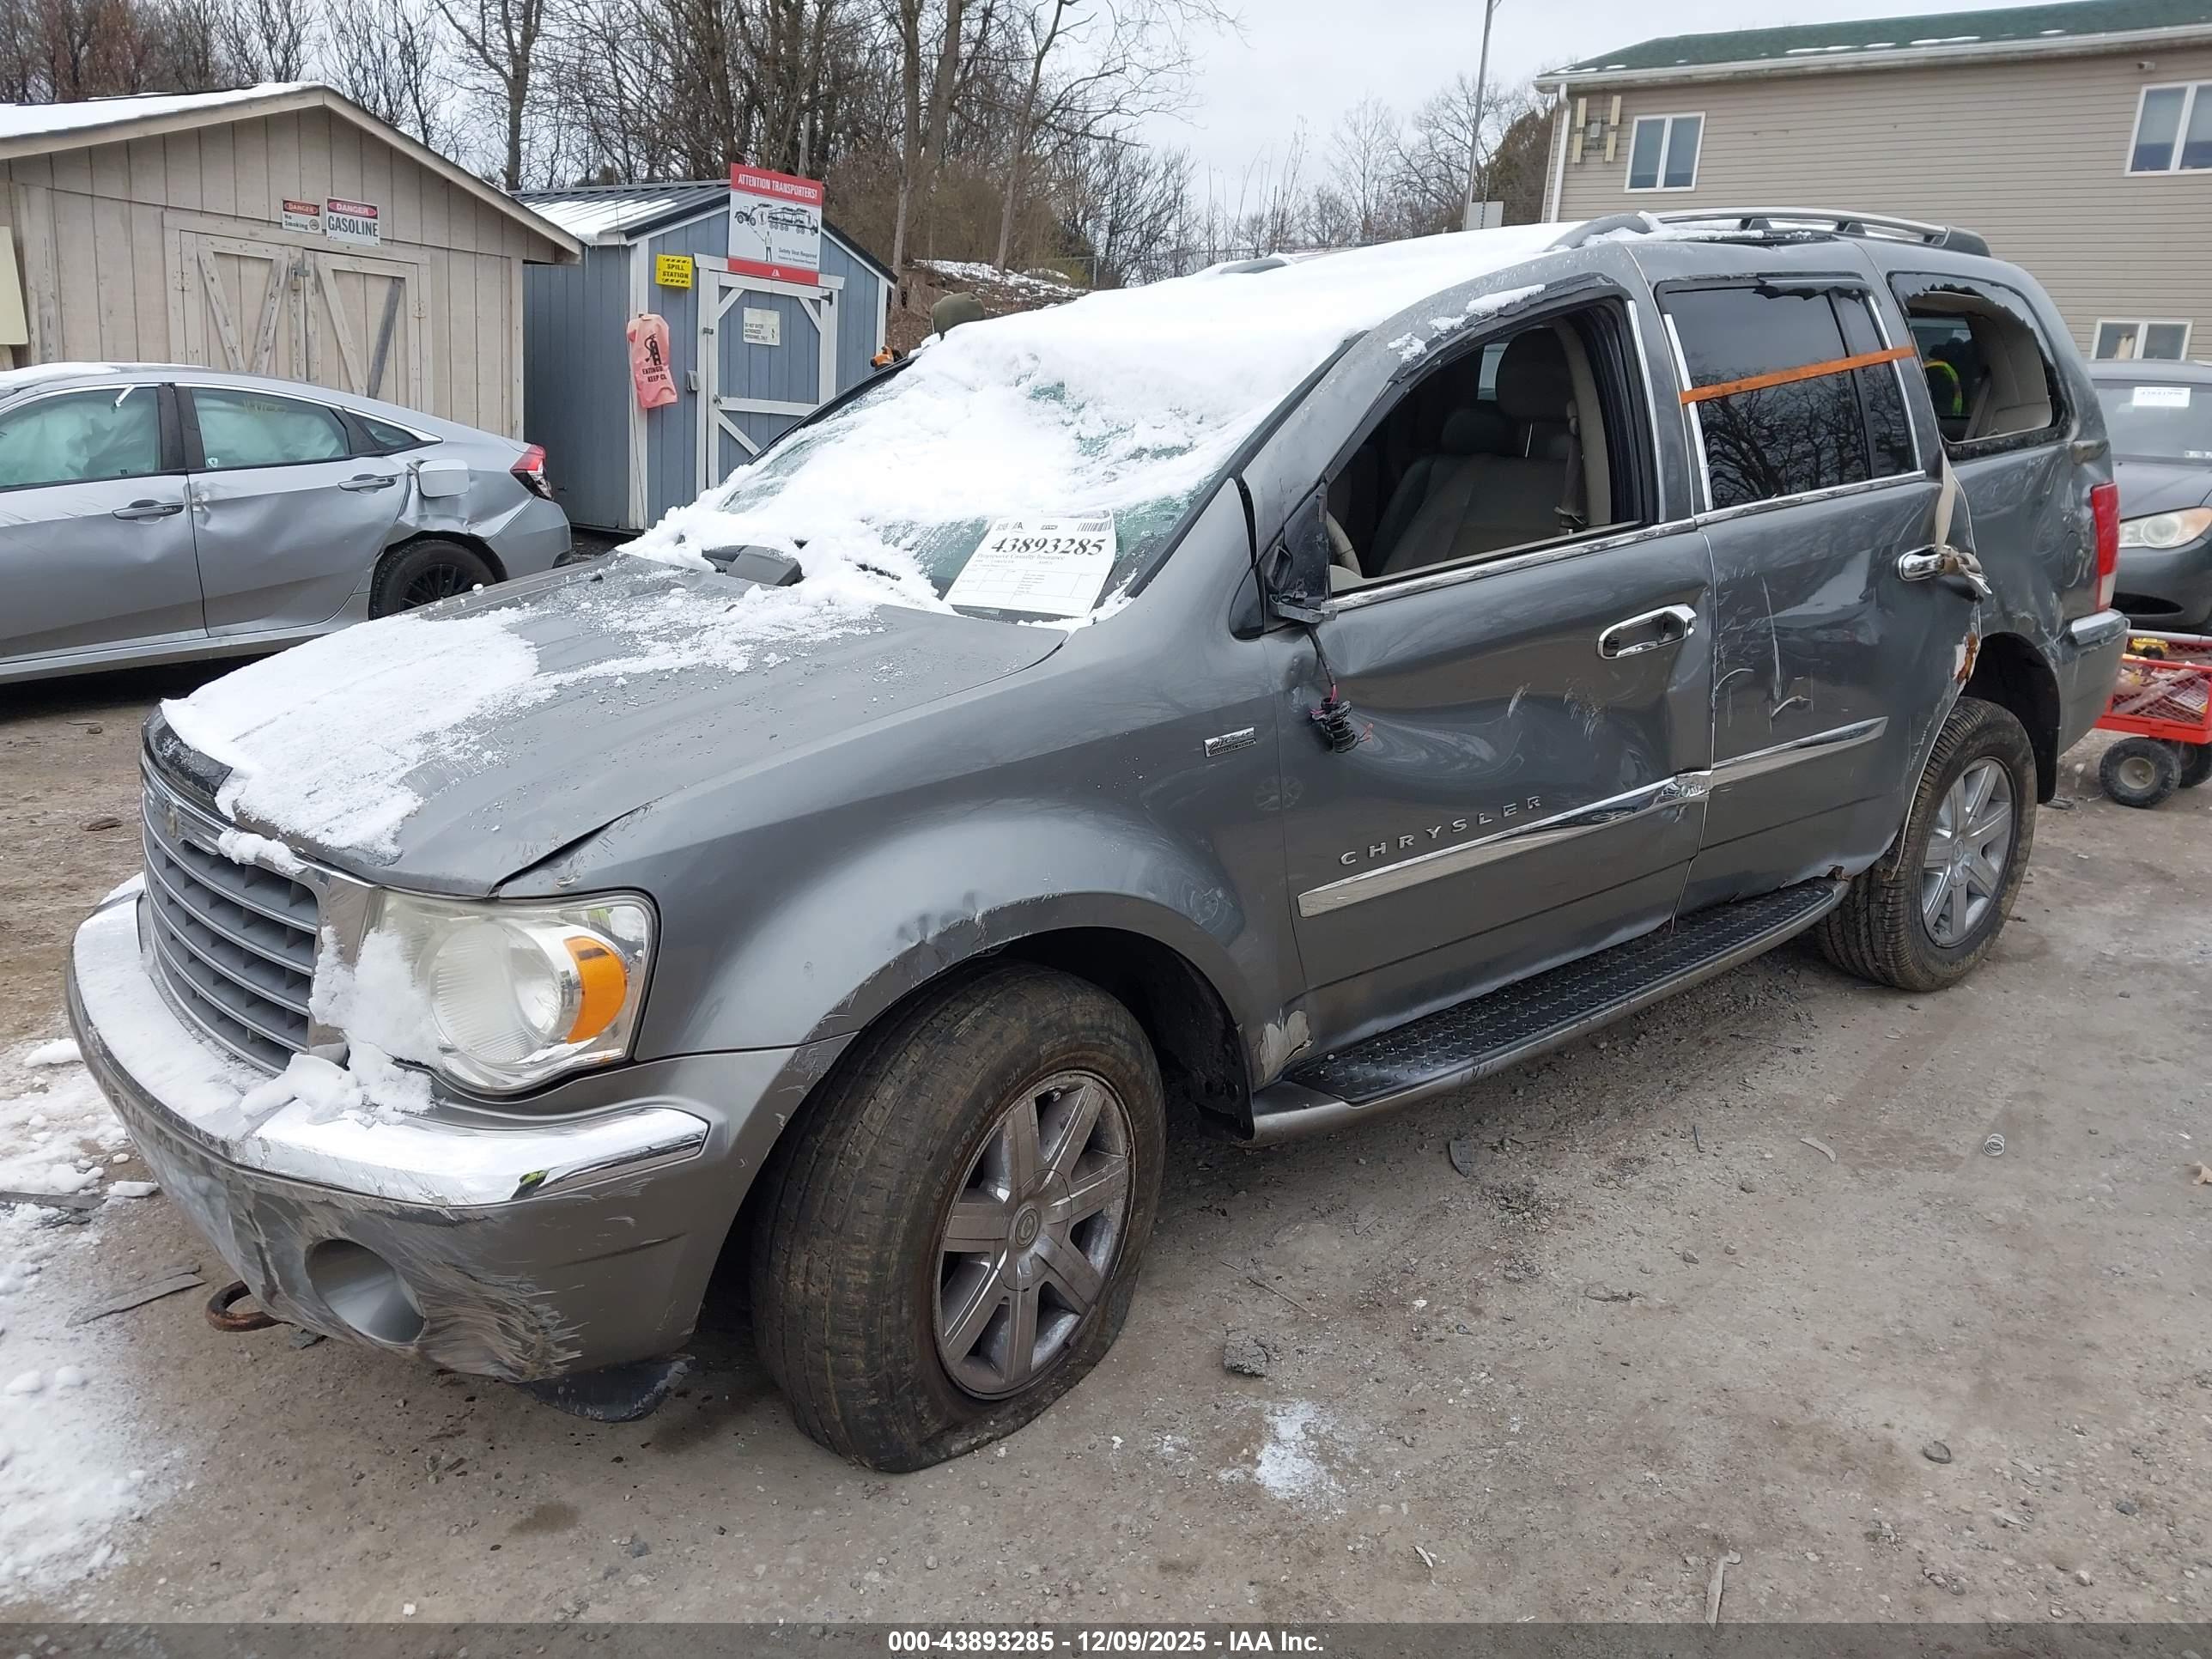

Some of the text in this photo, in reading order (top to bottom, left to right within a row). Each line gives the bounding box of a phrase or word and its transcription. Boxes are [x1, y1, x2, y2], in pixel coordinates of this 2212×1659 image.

[738, 173, 818, 199] ATTENTION TRANSPORTERS!
[289, 202, 314, 213] DANGER
[336, 203, 370, 216] DANGER
[284, 220, 308, 230] Smoking
[328, 216, 379, 237] GASOLINE
[662, 270, 690, 279] STATION
[647, 374, 659, 383] KEEP
[991, 537, 1107, 556] 43893285
[1339, 795, 1542, 866] CHRYSLER
